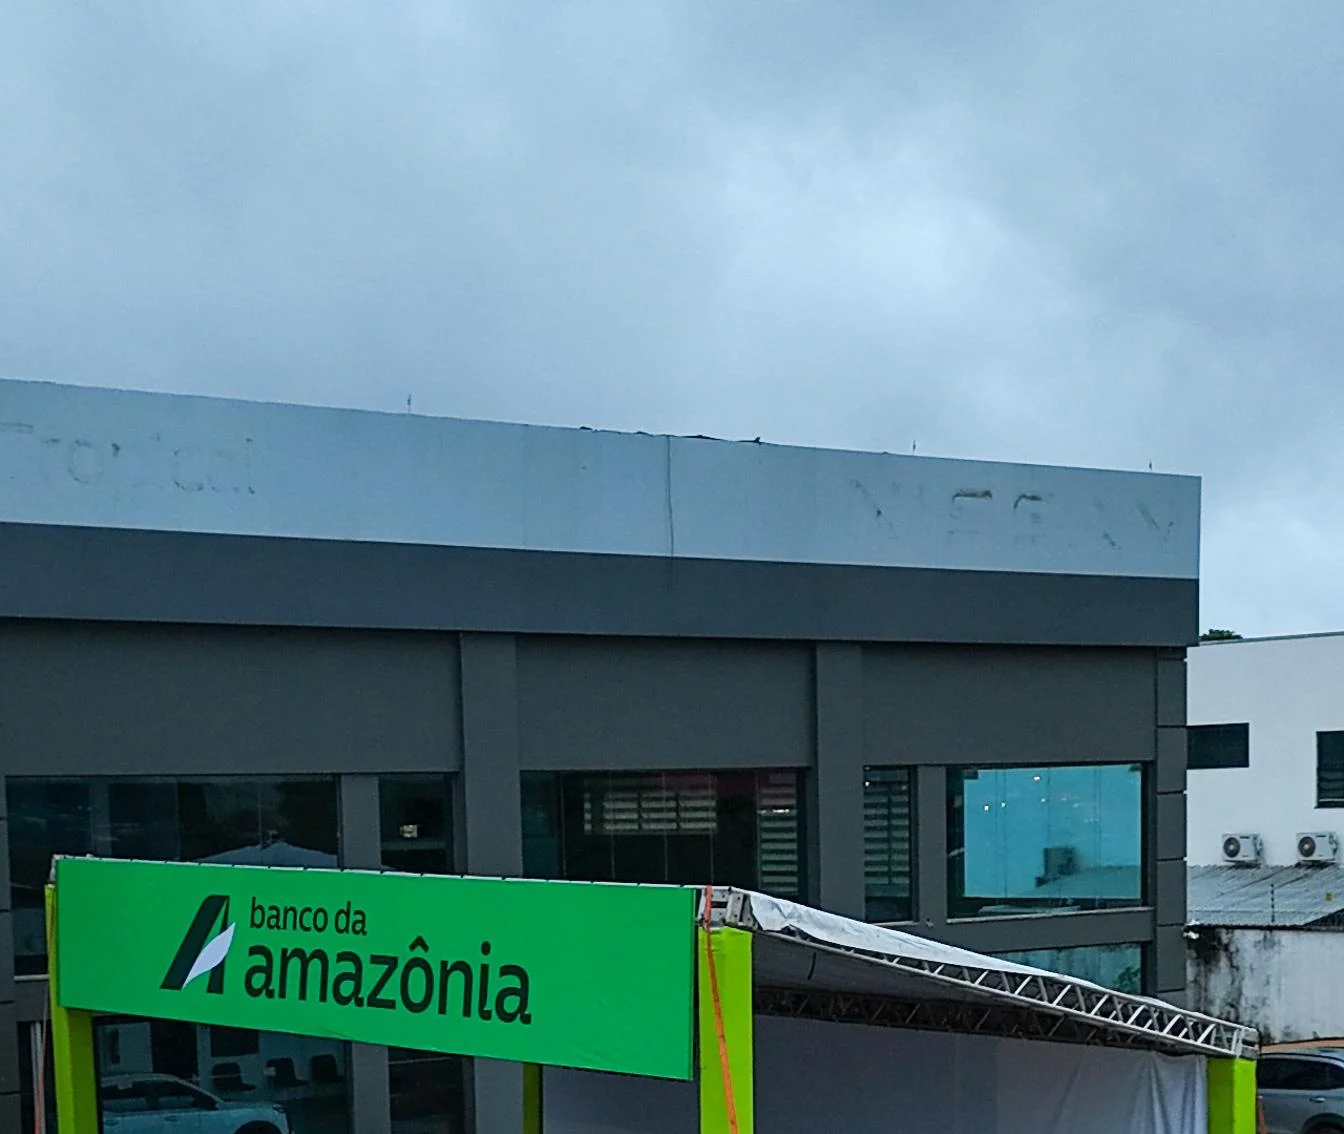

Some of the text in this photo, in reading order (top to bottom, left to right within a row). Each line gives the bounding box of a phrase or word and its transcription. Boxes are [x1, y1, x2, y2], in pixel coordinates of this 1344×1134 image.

[249, 896, 368, 936] banco da
[244, 935, 532, 1025] amazônia
